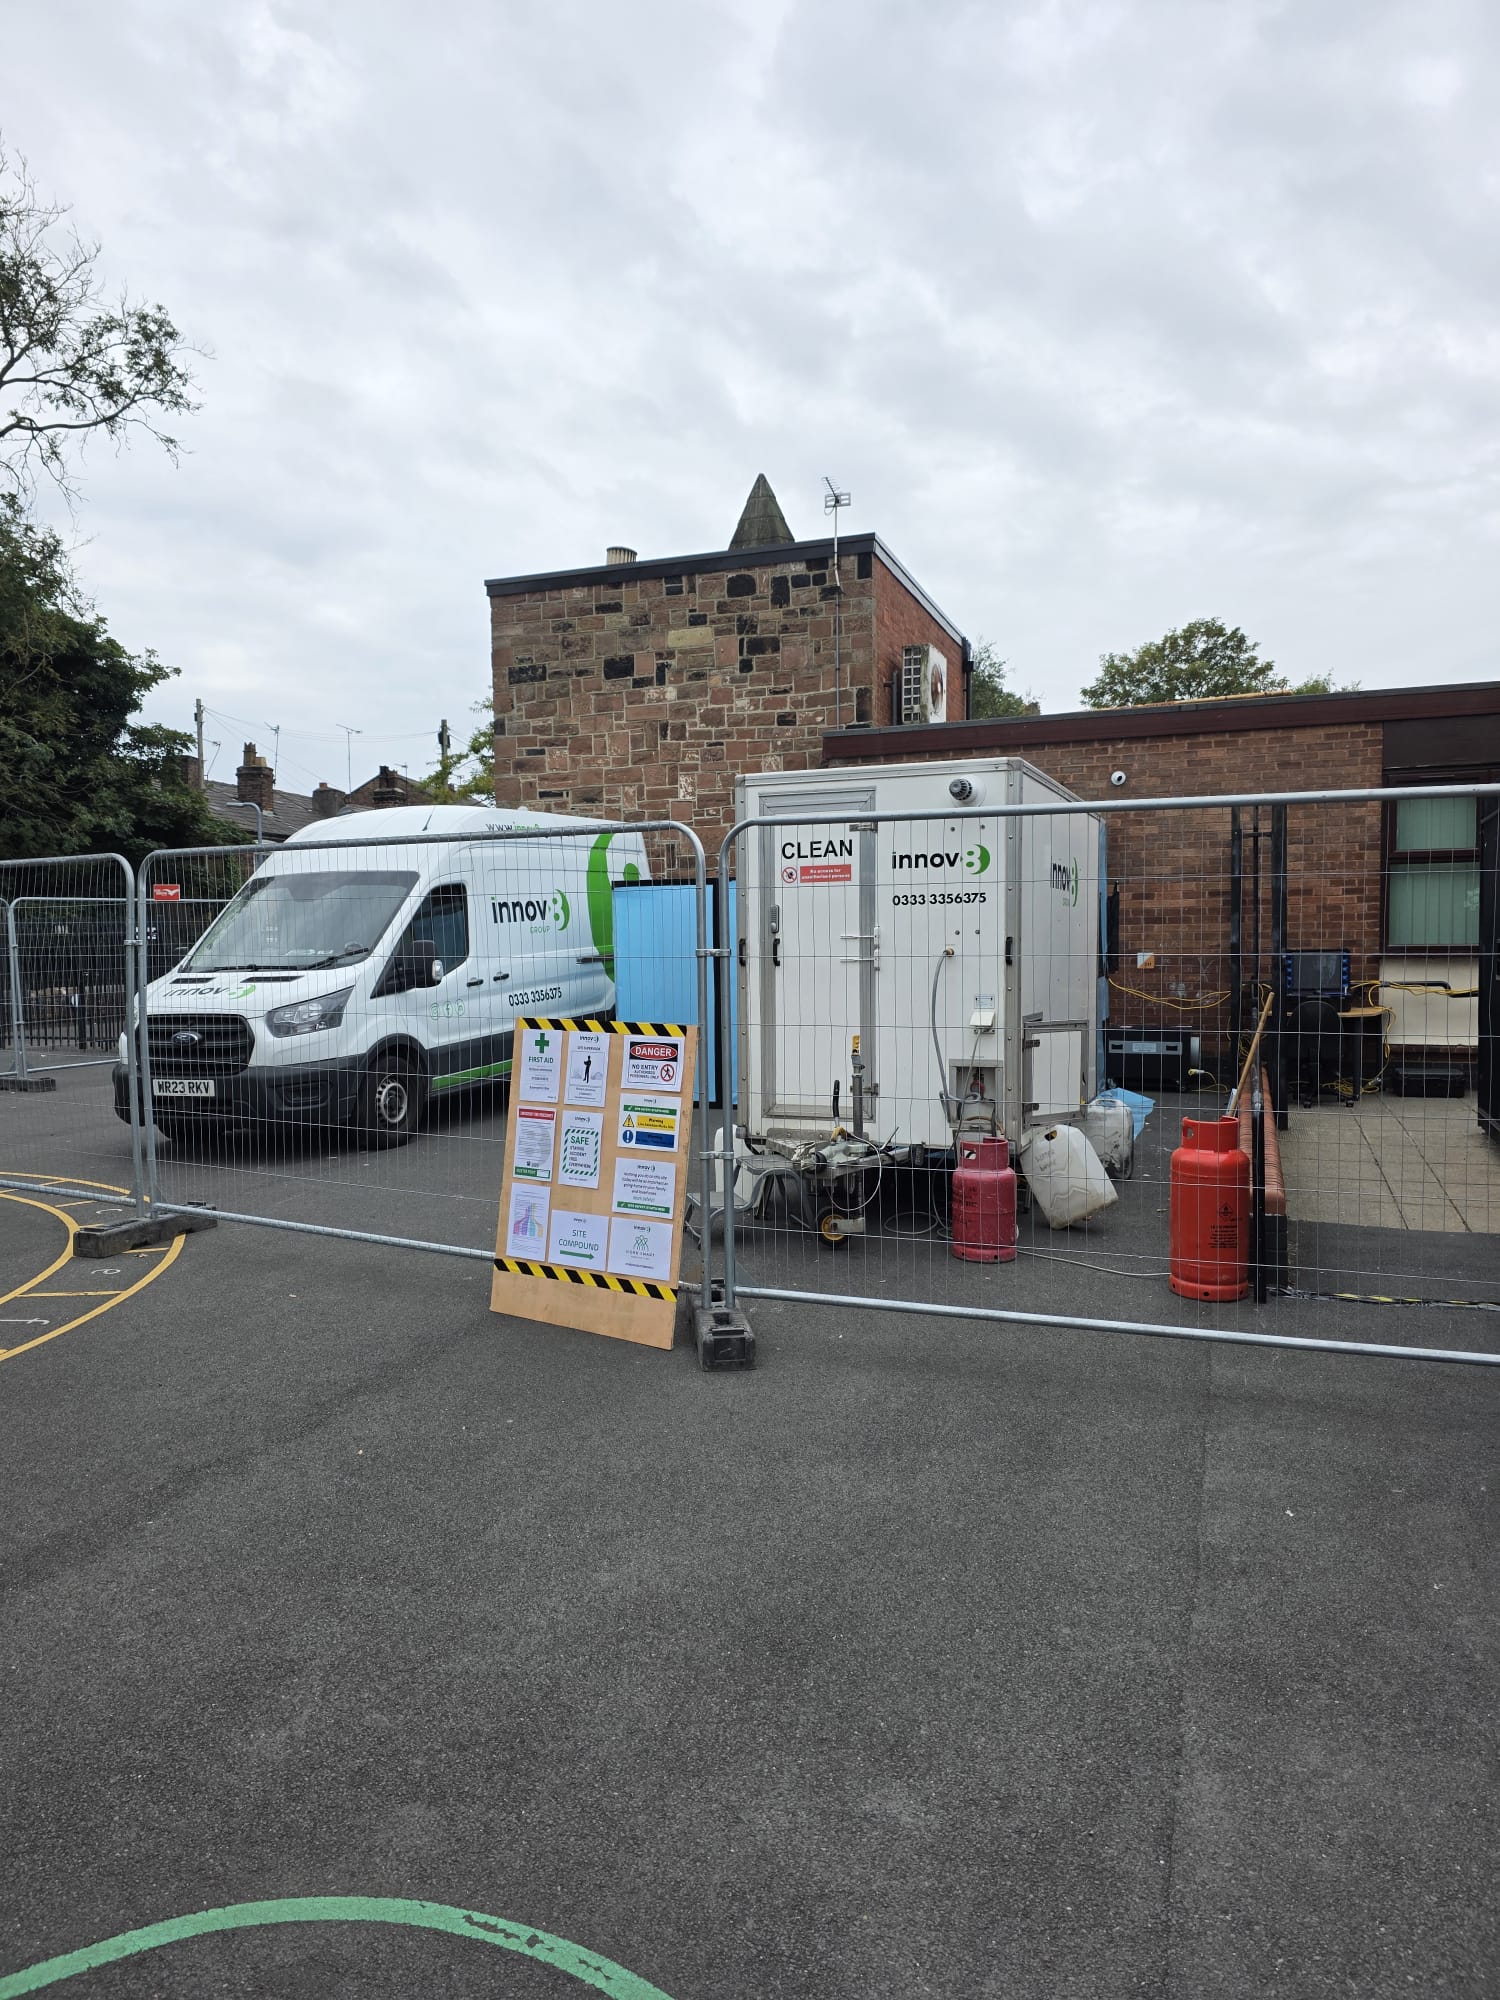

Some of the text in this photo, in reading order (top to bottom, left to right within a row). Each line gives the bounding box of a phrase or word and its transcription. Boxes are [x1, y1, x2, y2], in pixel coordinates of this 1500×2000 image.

[782, 839, 852, 859] CLEAN
[892, 892, 987, 906] 0333 3356375
[530, 925, 551, 934] GROUP
[508, 987, 562, 1007] 0333 3356375
[635, 1046, 672, 1057] DANGER
[528, 1056, 543, 1064] FIRST
[188, 1081, 210, 1094] RKV
[570, 1135, 590, 1146] SAFE
[571, 1229, 588, 1238] SITE
[558, 1238, 599, 1252] COMPOUND
